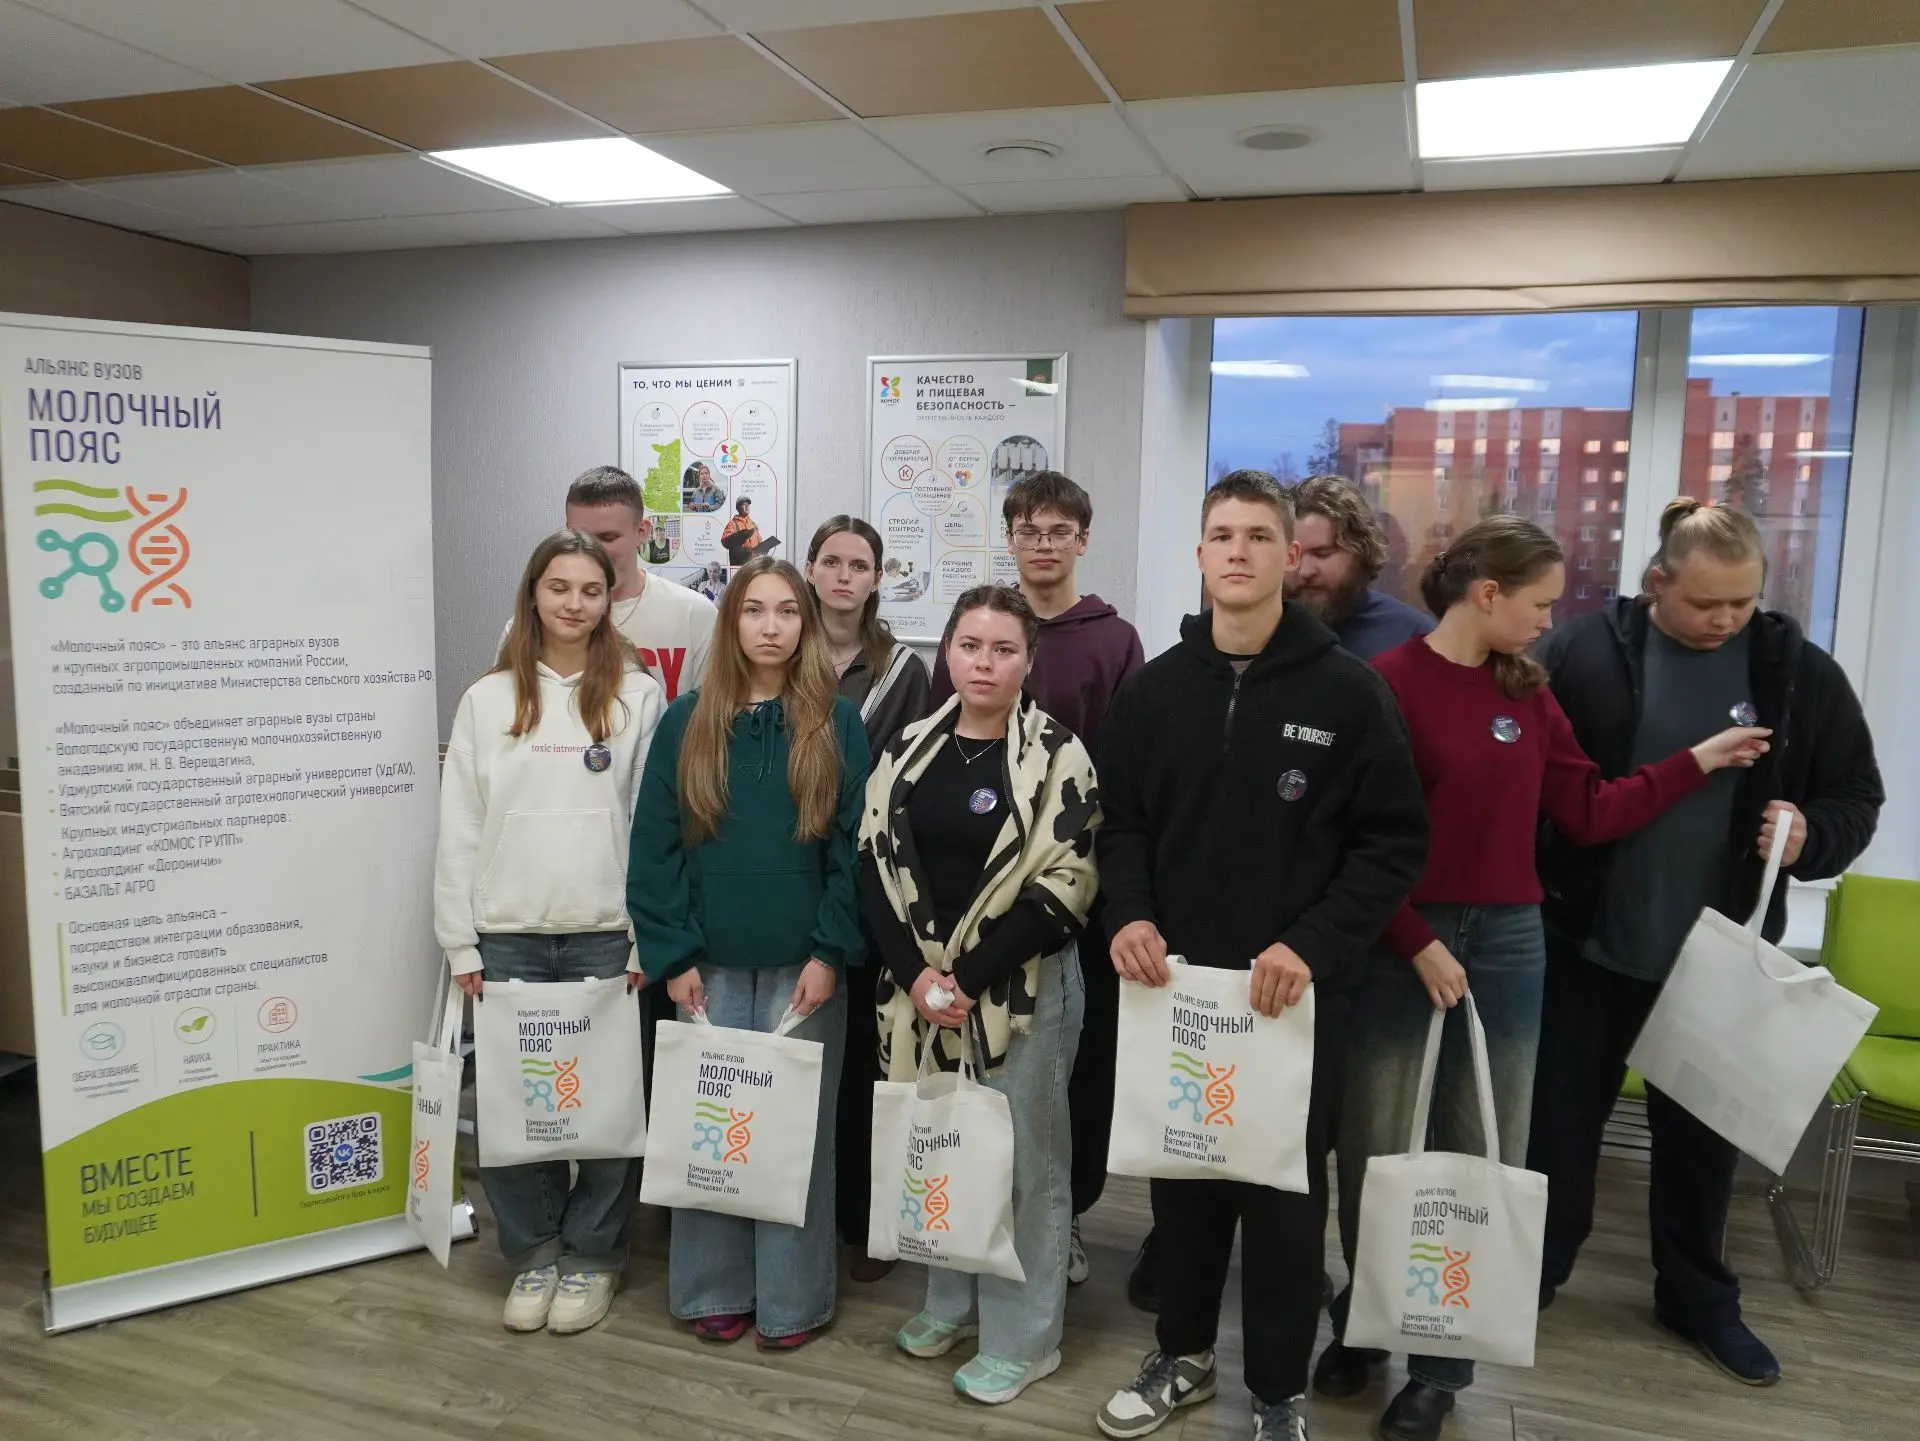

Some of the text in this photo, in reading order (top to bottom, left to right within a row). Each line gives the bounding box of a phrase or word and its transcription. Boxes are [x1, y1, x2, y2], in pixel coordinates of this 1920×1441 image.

[24, 357, 143, 380] АЛЬЯНС ВУЗОВ
[917, 375, 974, 385] КАЧЕСТВО
[633, 379, 732, 390] ТО, ЧТО МЫ ЦЕНИМ
[917, 387, 985, 399] И ПИЩЕВАЯ
[27, 387, 222, 430] МОЛОЧНЫЙ
[916, 401, 1005, 411] БЕЗОПАСНОСТЬ
[29, 428, 121, 465] ПОЯС
[51, 637, 340, 653] «Молочный пояс» это альянс аграрных вузов
[52, 653, 348, 676] и крупных агропромышленных компаний России,
[53, 678, 123, 695] созданный
[128, 681, 142, 692] по
[146, 678, 217, 692] инициативе
[221, 674, 301, 690] Министерства
[305, 673, 360, 686] сельского
[364, 669, 415, 684] хозяйства
[55, 710, 376, 736] «Молочный пояс» объединяет аграрные вузы страны
[1283, 723, 1336, 746] BE YOURSELF
[56, 728, 382, 758] Вологодскую государственную молочнохозяйственную
[532, 743, 552, 753] toxic
[553, 743, 588, 753] introvert
[58, 754, 256, 778] академию им. Н. В. Верещагина,
[59, 761, 416, 800] Удмуртский государственный аграрный университет (УдГАУ),
[59, 781, 414, 819] Вятский государственный агротехнологический университет
[61, 824, 117, 842] Крупных
[121, 817, 222, 838] индустриальных
[63, 833, 243, 862] Агрохолдинг «КОМОС ГРУПП»
[64, 856, 222, 882] Агрохолдинг «Дороничи»
[65, 878, 156, 901] БАЗАЛЬТ АГРО
[69, 908, 216, 934] Основная цель альянса
[69, 917, 303, 956] посредством интеграции образования,
[71, 946, 227, 976] науки и бизнеса готовить
[73, 952, 328, 995] высококвалифицированных специалистов
[73, 980, 260, 1017] для молочной отрасли страны.
[1173, 992, 1219, 1010] АЛЬЯНС ВУЗОВ
[517, 1009, 560, 1018] АЛЬЯНС ВУЗОВ
[1173, 1006, 1254, 1034] МОЛОЧНЫЙ
[518, 1015, 591, 1037] МОЛОЧНЫЙ
[257, 1039, 301, 1055] ПРАКТИКА
[519, 1038, 553, 1053] ПОЯС
[1172, 1026, 1206, 1050] ПОЯС
[183, 1052, 211, 1065] НАУКА
[701, 1051, 745, 1064] АЛЬЯНС ВУЗОВ
[72, 1062, 140, 1083] ОБРАЗОВАНИЕ
[700, 1063, 773, 1089] МОЛОЧНЫЙ
[697, 1080, 732, 1099] ПОЯС
[417, 1098, 442, 1116] ЧНЫЙ
[1165, 1126, 1218, 1145] Удмуртский ГАУ
[1193, 1140, 1209, 1152] ГАТУ
[1163, 1145, 1227, 1164] Вологодская ГМХА
[80, 1146, 192, 1195] ВМЕСТЕ
[82, 1180, 195, 1218] МЫ СОЗДАЕМ
[1437, 1188, 1457, 1197] ВУЗОВ
[1413, 1201, 1489, 1226] МОЛОЧНЫЙ
[84, 1213, 159, 1244] БУДУЩЕЕ
[1411, 1220, 1445, 1236] ПОЯС
